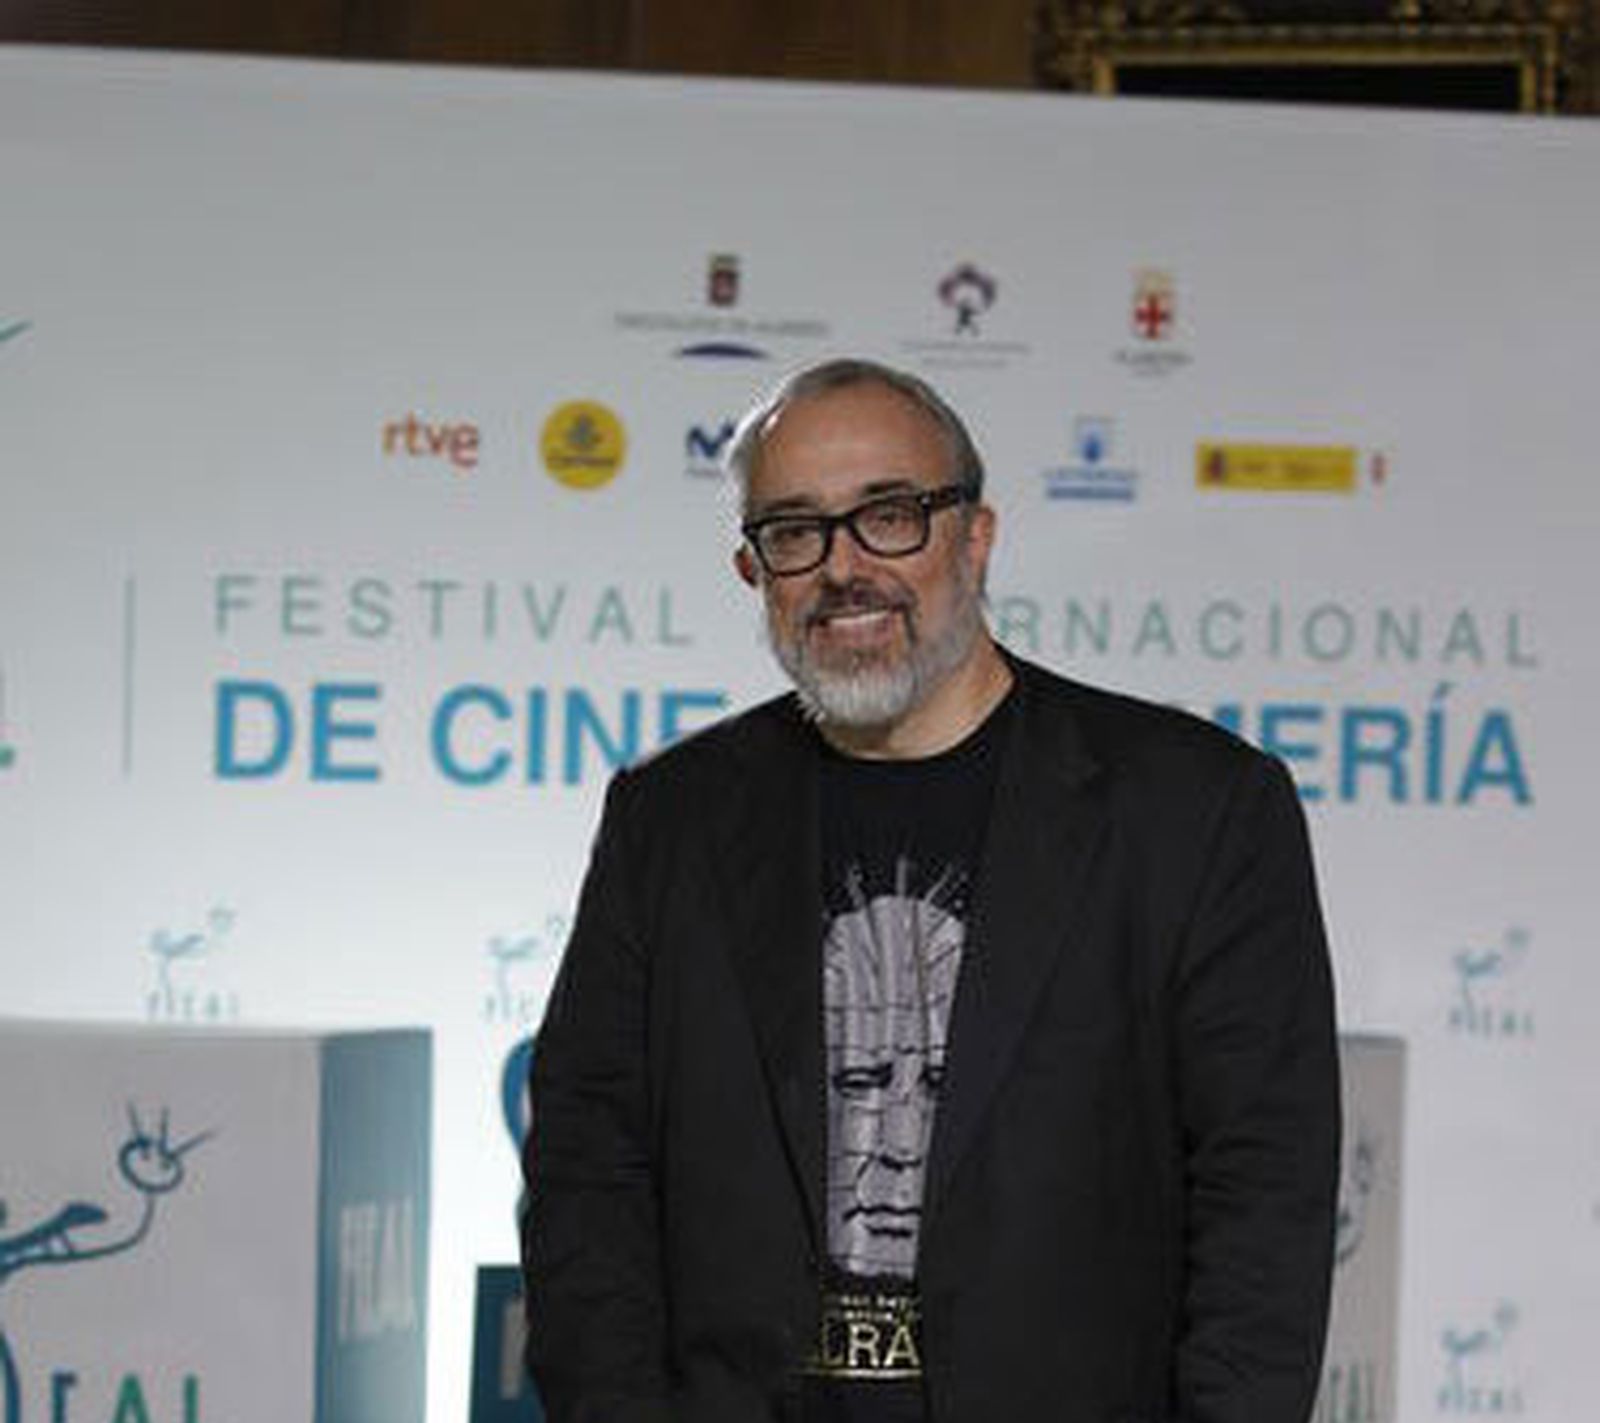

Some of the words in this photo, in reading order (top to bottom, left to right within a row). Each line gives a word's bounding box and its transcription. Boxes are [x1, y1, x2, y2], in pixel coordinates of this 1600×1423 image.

[382, 411, 478, 467] rtve
[214, 575, 694, 645] FESTIVAL
[1000, 598, 1538, 668] RNACIONAL
[213, 681, 382, 781] DE
